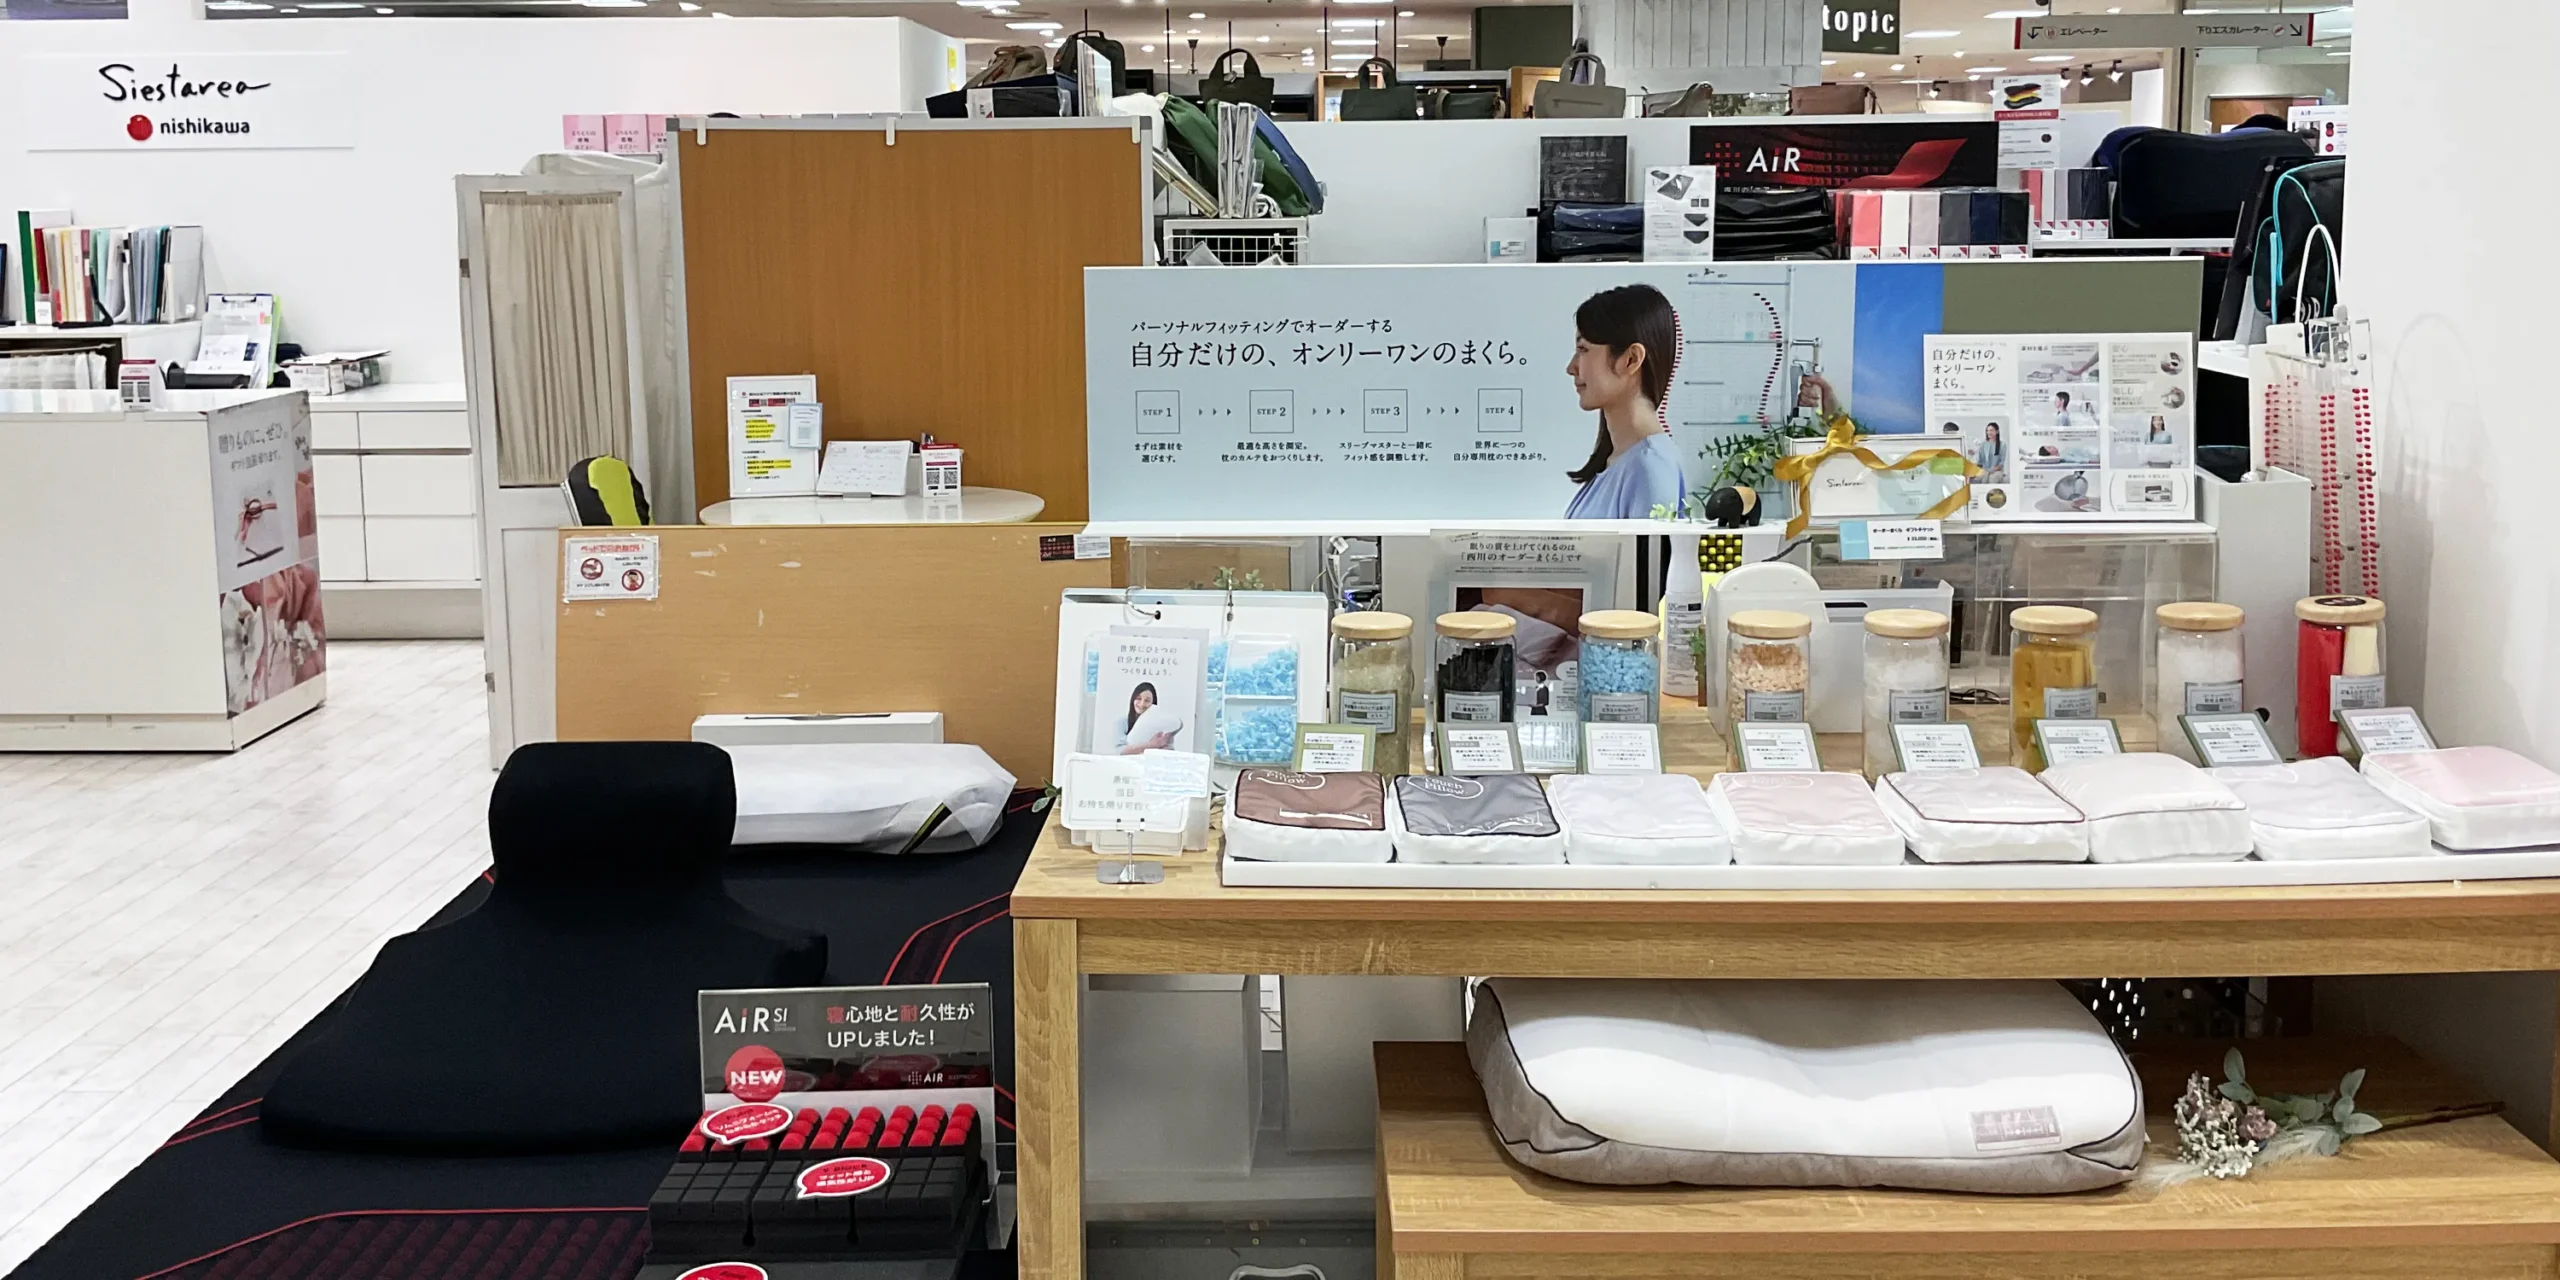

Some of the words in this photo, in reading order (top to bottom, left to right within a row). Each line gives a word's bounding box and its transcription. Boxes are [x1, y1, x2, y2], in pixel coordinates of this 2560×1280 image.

[1822, 5, 1894, 42] topic
[2060, 27, 2108, 36] エレベーター
[2197, 25, 2268, 35] 下りエスカレーター
[99, 63, 271, 101] Siestarea
[160, 118, 250, 134] nishikawa
[1131, 318, 1392, 335] パーソナルフィッティングでオーダーする
[1132, 340, 1527, 368] 自分だけの、オンリーワンのまくら。
[1933, 348, 2001, 361] 自分だけの、
[1933, 364, 1996, 374] オンリーワン
[1933, 378, 1965, 389] まくら。
[1166, 407, 1172, 417] 1
[1279, 407, 1286, 417] 2
[1393, 406, 1400, 416] 3
[1508, 406, 1514, 415] 4
[1134, 443, 1183, 451] まずは素材を
[1237, 442, 1307, 451] 最適な高さを測定。
[1340, 441, 1433, 449] スリープマスターと一緒に
[1475, 441, 1526, 449] 世界に一つの
[1142, 454, 1176, 463] 選びます。
[1222, 454, 1324, 463] 枕のカルテをおつくりします。
[1344, 453, 1429, 462] フィット感を調整します。
[1453, 453, 1547, 462] 自分専用枕のできあがり。
[1470, 542, 1575, 551] 眠りの質を上げてくれるのは
[1461, 552, 1582, 562] 「西川のオーダーまくら」です
[1120, 645, 1177, 654] 世界にひとつの
[1117, 656, 1178, 666] 自分だけのまくら
[1121, 667, 1172, 677] つくりましょう。
[1116, 789, 1134, 797] 当日
[826, 1003, 975, 1024] 寝心地と耐久性が
[731, 1069, 784, 1085] NEW
